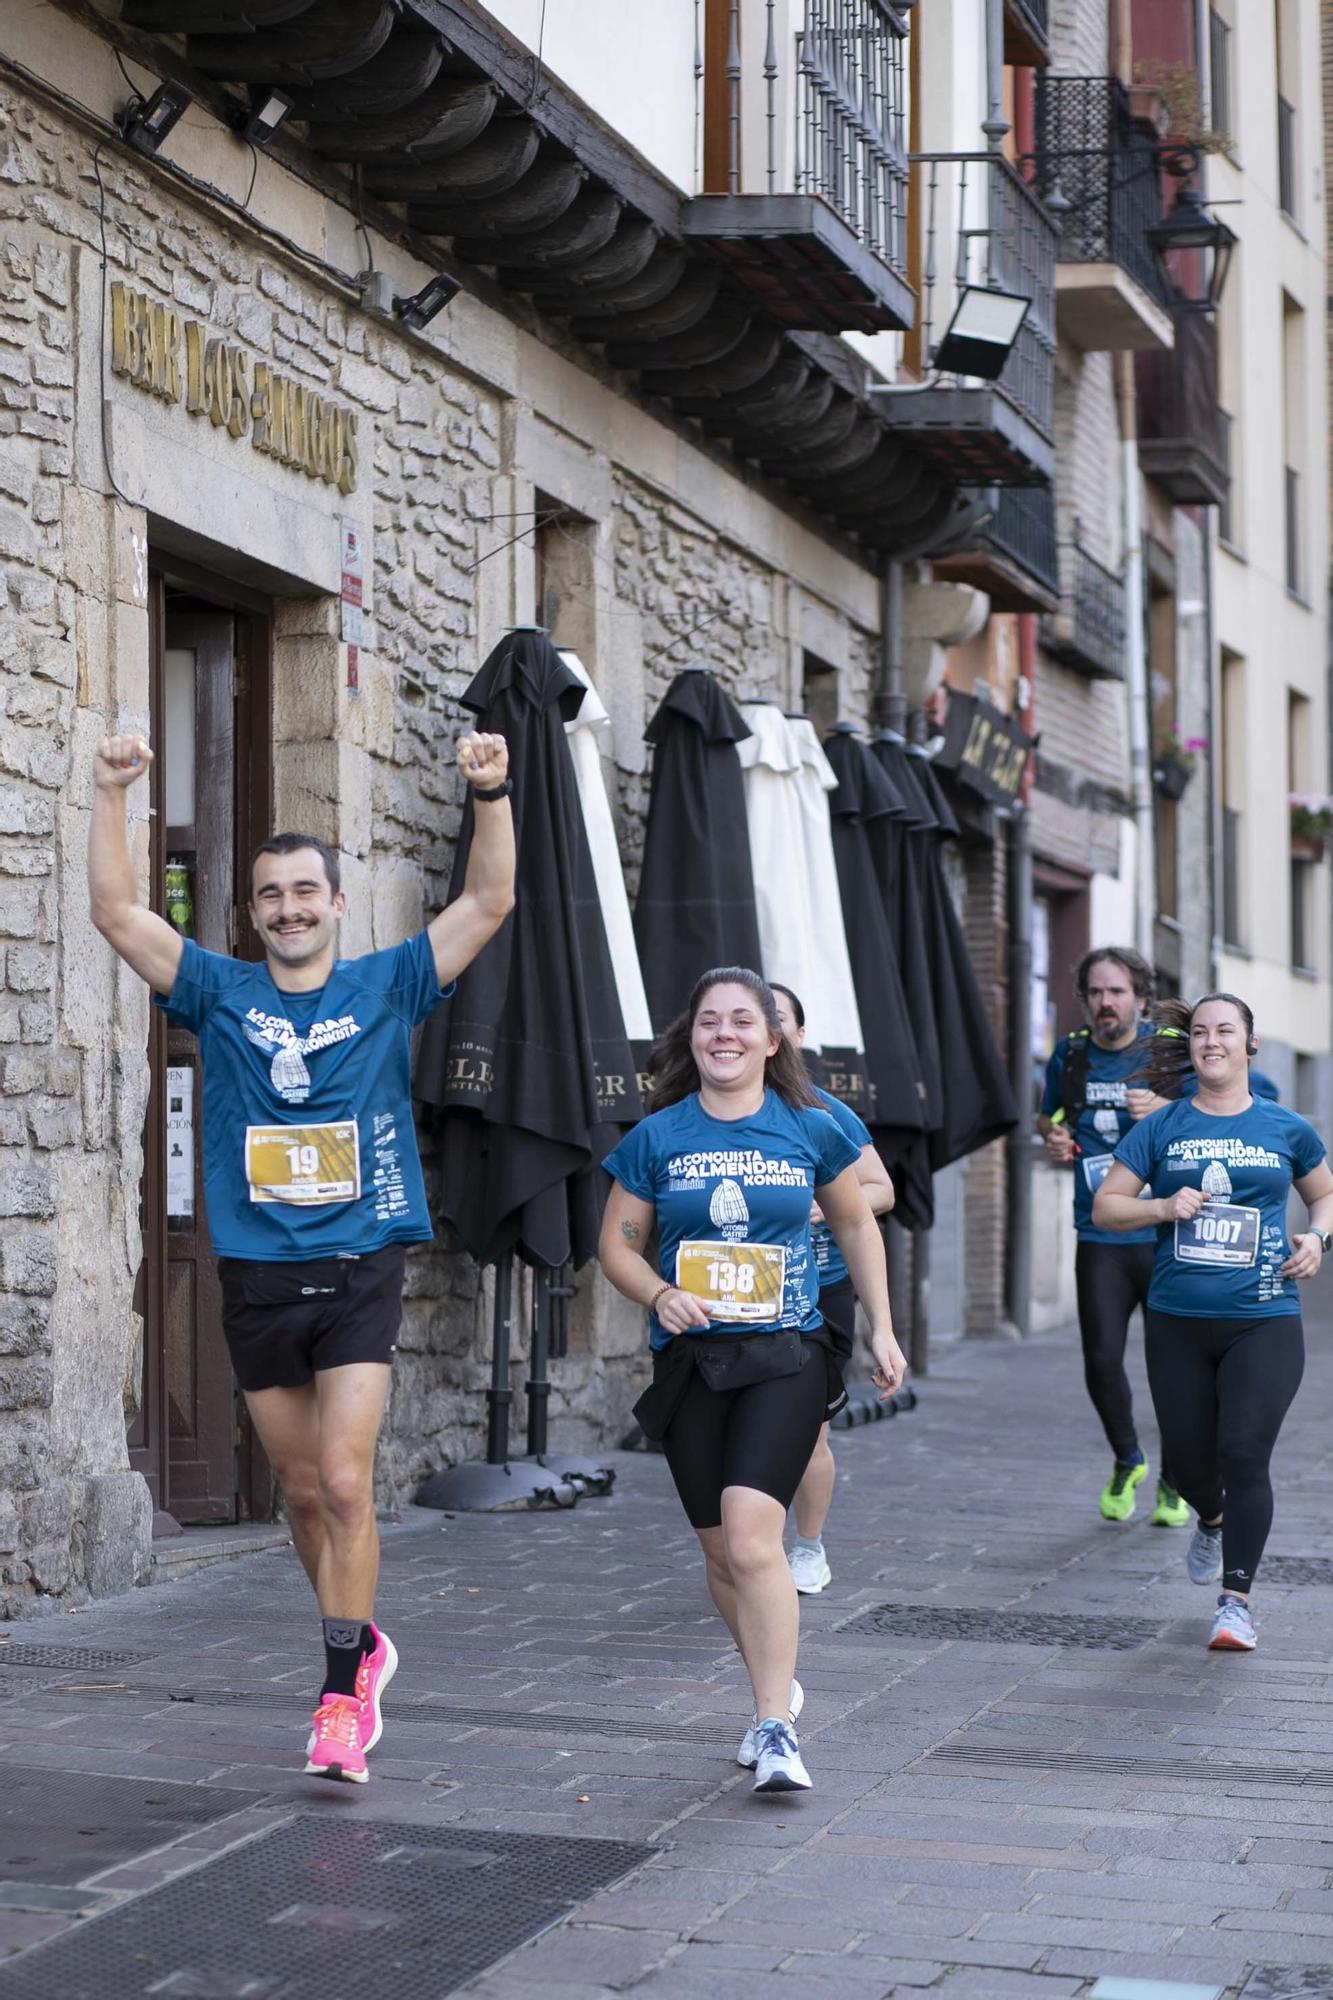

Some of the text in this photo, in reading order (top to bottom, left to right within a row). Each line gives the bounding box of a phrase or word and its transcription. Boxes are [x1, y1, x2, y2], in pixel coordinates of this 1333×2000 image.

[111, 281, 358, 497] BAR LOS AMIGOS
[1168, 1138, 1244, 1151] LA CONQUISTA
[1182, 1146, 1266, 1160] ALMENDRA
[286, 1145, 319, 1176] 19
[668, 1150, 763, 1170] LA CONQUISTA
[685, 1159, 793, 1179] ALMENDRA
[1227, 1157, 1281, 1169] KONKISTA
[743, 1174, 809, 1188] KONKISTA
[721, 1230, 749, 1239] GASTEIZ
[1192, 1217, 1242, 1244] 1007
[706, 1262, 755, 1293] 138
